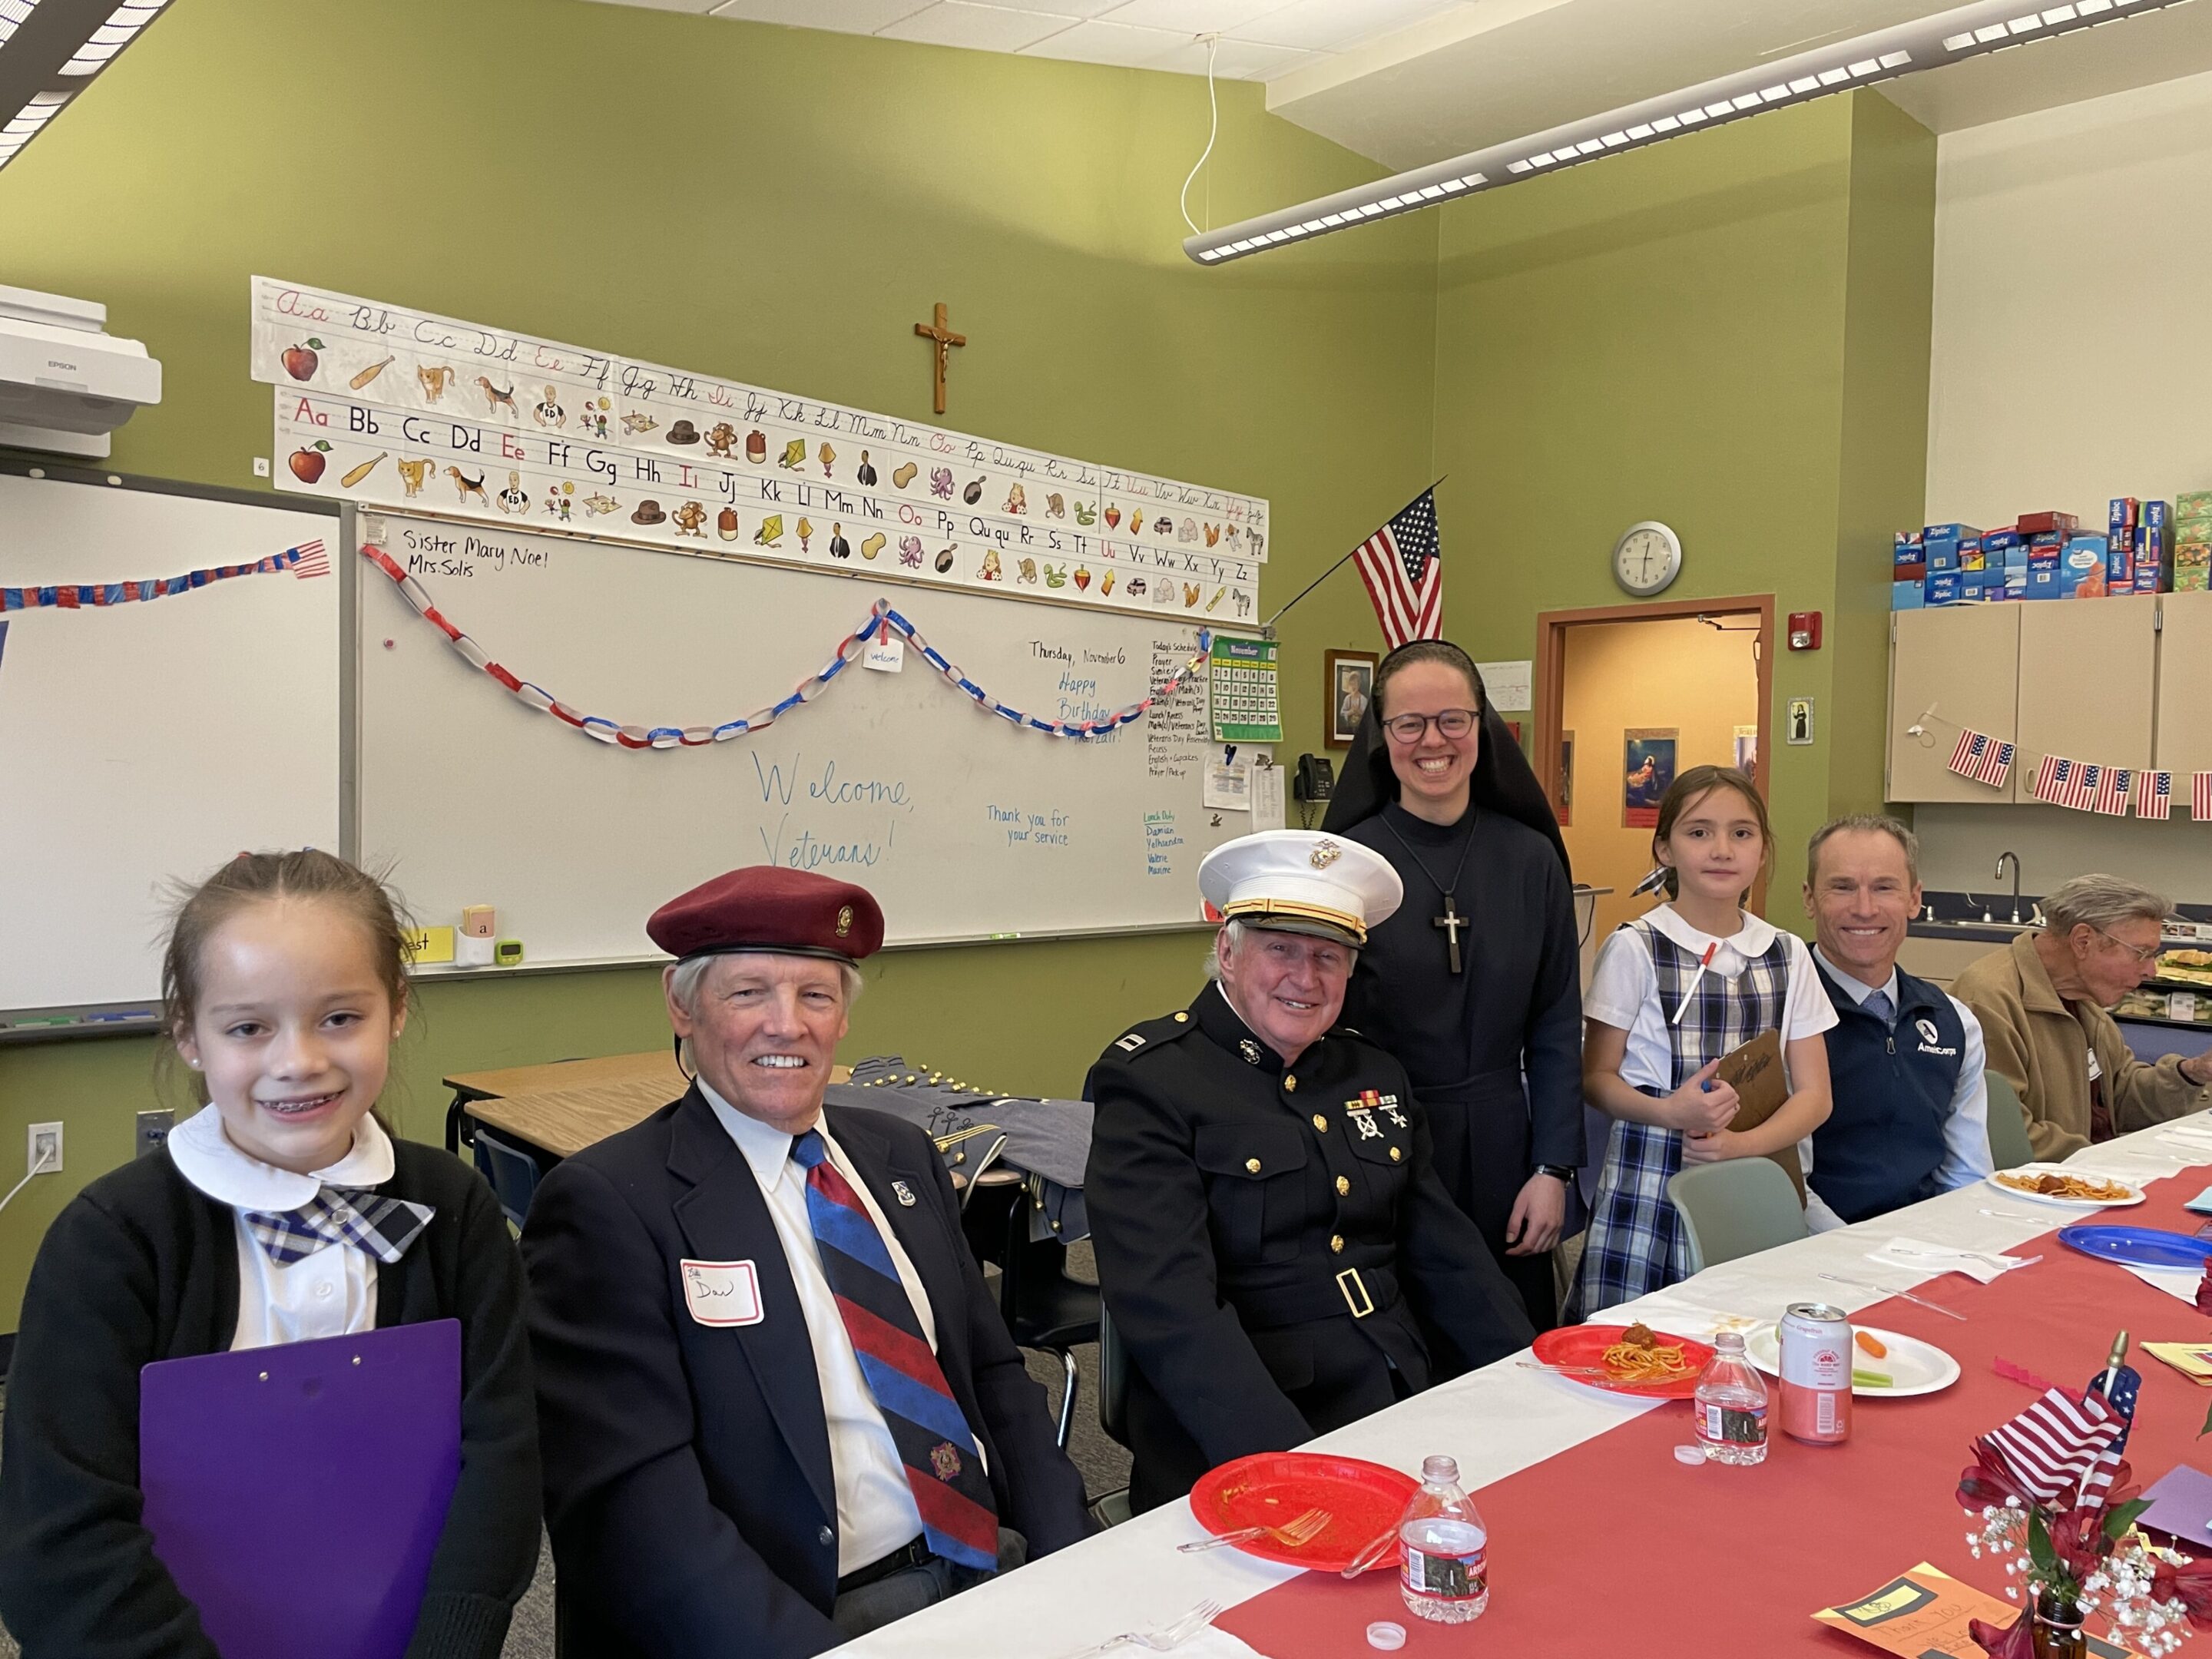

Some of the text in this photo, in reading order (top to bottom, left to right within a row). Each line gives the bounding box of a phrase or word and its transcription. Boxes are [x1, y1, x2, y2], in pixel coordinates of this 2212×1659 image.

[48, 360, 77, 371] EPSON
[277, 290, 329, 322] Aa
[349, 306, 396, 334] Bb
[414, 320, 456, 348] Cc
[474, 332, 518, 362] Dd
[535, 346, 565, 371] Ee
[580, 355, 611, 390] Ff
[621, 366, 657, 399] Gg
[667, 374, 698, 400] Hh
[708, 386, 734, 408] Ii
[744, 392, 768, 422] Jj
[777, 398, 805, 422] Kk
[814, 407, 840, 429] Ll
[849, 413, 886, 439] Mm
[891, 422, 920, 447] Nn
[929, 433, 956, 454] Oo
[965, 441, 986, 469] Pp
[1045, 459, 1068, 480] Rr
[1075, 466, 1096, 486] Ss
[1103, 471, 1121, 490] Tt
[1125, 475, 1149, 496] Uu
[1153, 480, 1173, 500] Vv
[1178, 486, 1199, 505] Ww
[1202, 492, 1220, 510] Xx
[1225, 495, 1243, 521] Yy
[544, 408, 556, 419] ED
[294, 397, 329, 427] Aa
[350, 406, 379, 435] Bb
[402, 417, 431, 444] Cc
[452, 424, 481, 453] Dd
[502, 433, 526, 461] Ee
[548, 442, 571, 468] Ff
[586, 450, 617, 485] Gg
[636, 458, 661, 483] Hh
[679, 465, 698, 488] Ii
[719, 472, 735, 504] Jj
[761, 478, 781, 502] Kk
[798, 485, 810, 507] Ll
[825, 490, 853, 515] Mm
[863, 497, 883, 519] Nn
[899, 504, 922, 526] Oo
[938, 510, 955, 539] Pp
[1021, 526, 1034, 545] Rr
[1048, 531, 1062, 550] Ss
[1073, 535, 1088, 555] Tt
[1101, 539, 1116, 559] Uu
[1129, 544, 1145, 564] Vv
[1154, 548, 1176, 569] Ww
[1184, 553, 1200, 573] Xx
[1210, 558, 1225, 584] Yy
[1236, 563, 1248, 581] Zz
[508, 495, 520, 505] ED
[2111, 501, 2122, 522] Ziploc
[1929, 527, 1951, 537] Ziploc
[403, 530, 548, 571] Sister Mary Noel
[2113, 556, 2122, 575] Ziploc
[1933, 590, 1953, 599] Ziploc
[1028, 641, 1126, 668] Thursday, November 6
[1230, 645, 1259, 656] November
[1153, 654, 1172, 668] Prayer
[1058, 672, 1096, 697] Happy
[1173, 734, 1184, 746] Day
[1148, 744, 1167, 753] Recess
[751, 750, 915, 813] Welcome,
[986, 805, 1069, 832] Thank you for
[1144, 811, 1160, 823] Lunch
[760, 813, 896, 870] Veterans!
[1008, 830, 1068, 847] your service
[1147, 853, 1168, 863] Valerie
[478, 925, 487, 934] a
[1796, 1324, 1823, 1335] Grapefruit
